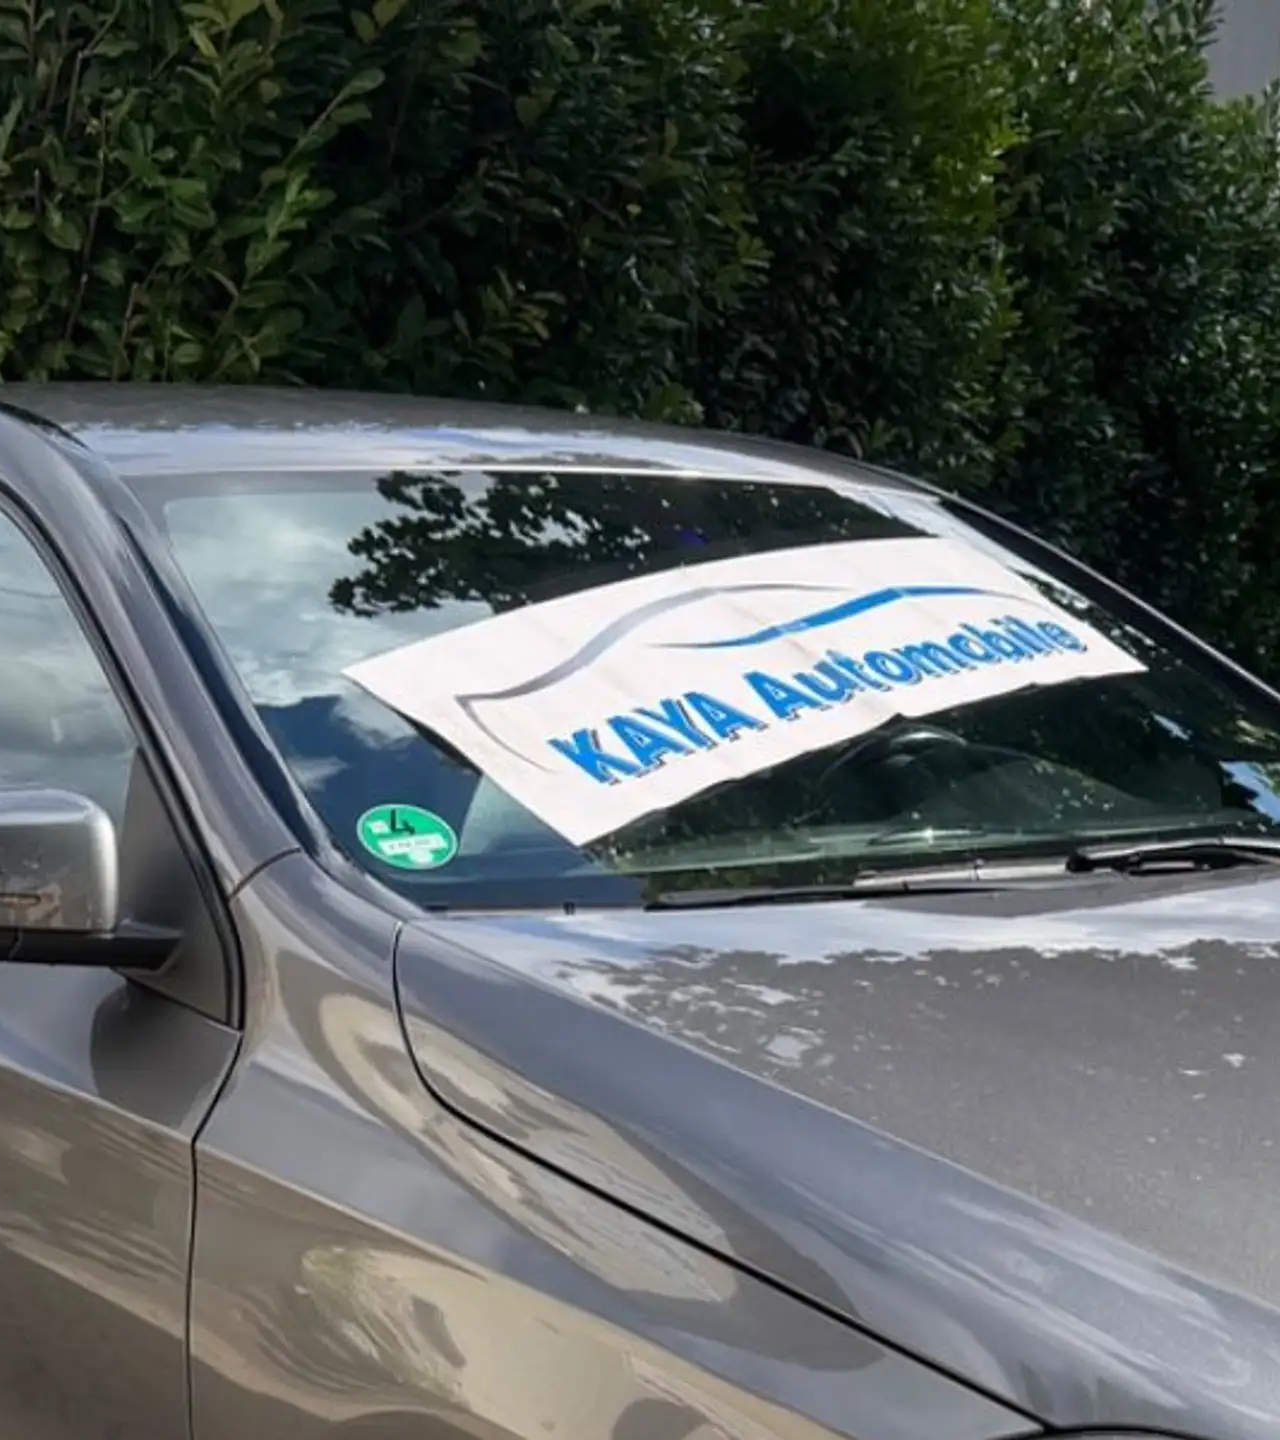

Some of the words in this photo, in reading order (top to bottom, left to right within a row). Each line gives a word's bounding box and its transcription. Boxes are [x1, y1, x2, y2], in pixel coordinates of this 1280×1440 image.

[548, 691, 768, 785] KAYA
[743, 614, 1087, 720] Automobile
[390, 808, 416, 834] 4
